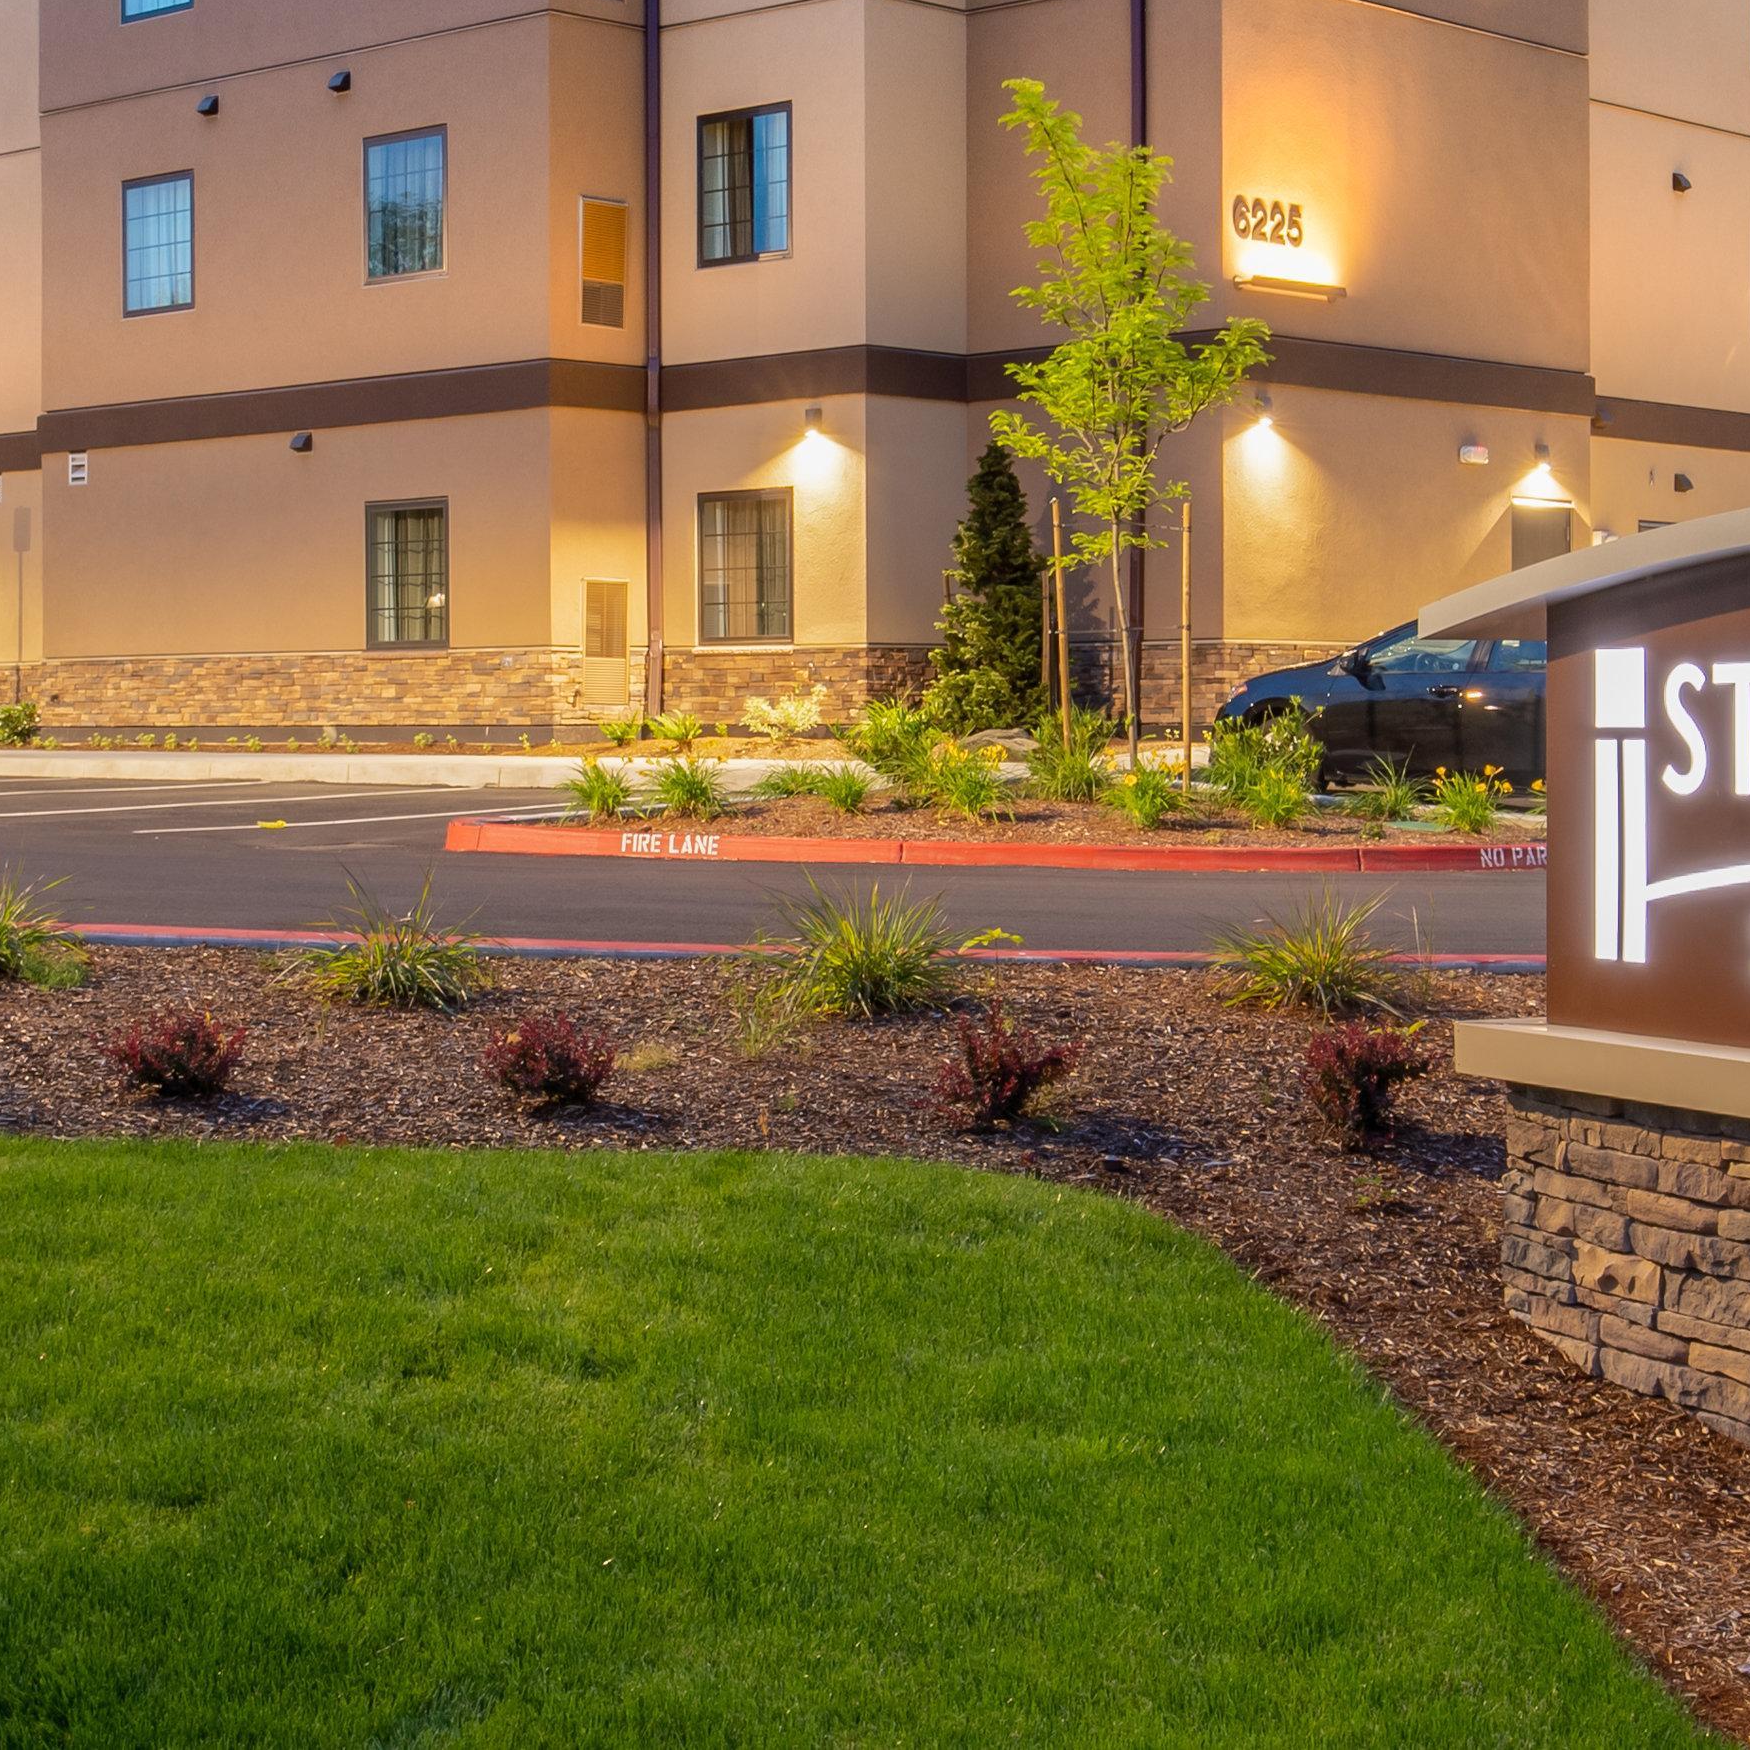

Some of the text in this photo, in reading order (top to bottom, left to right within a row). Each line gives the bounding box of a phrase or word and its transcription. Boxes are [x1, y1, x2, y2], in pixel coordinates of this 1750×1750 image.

[1233, 194, 1303, 247] 6225
[621, 833, 720, 855] FIRE LANE
[1480, 848, 1504, 867] NO
